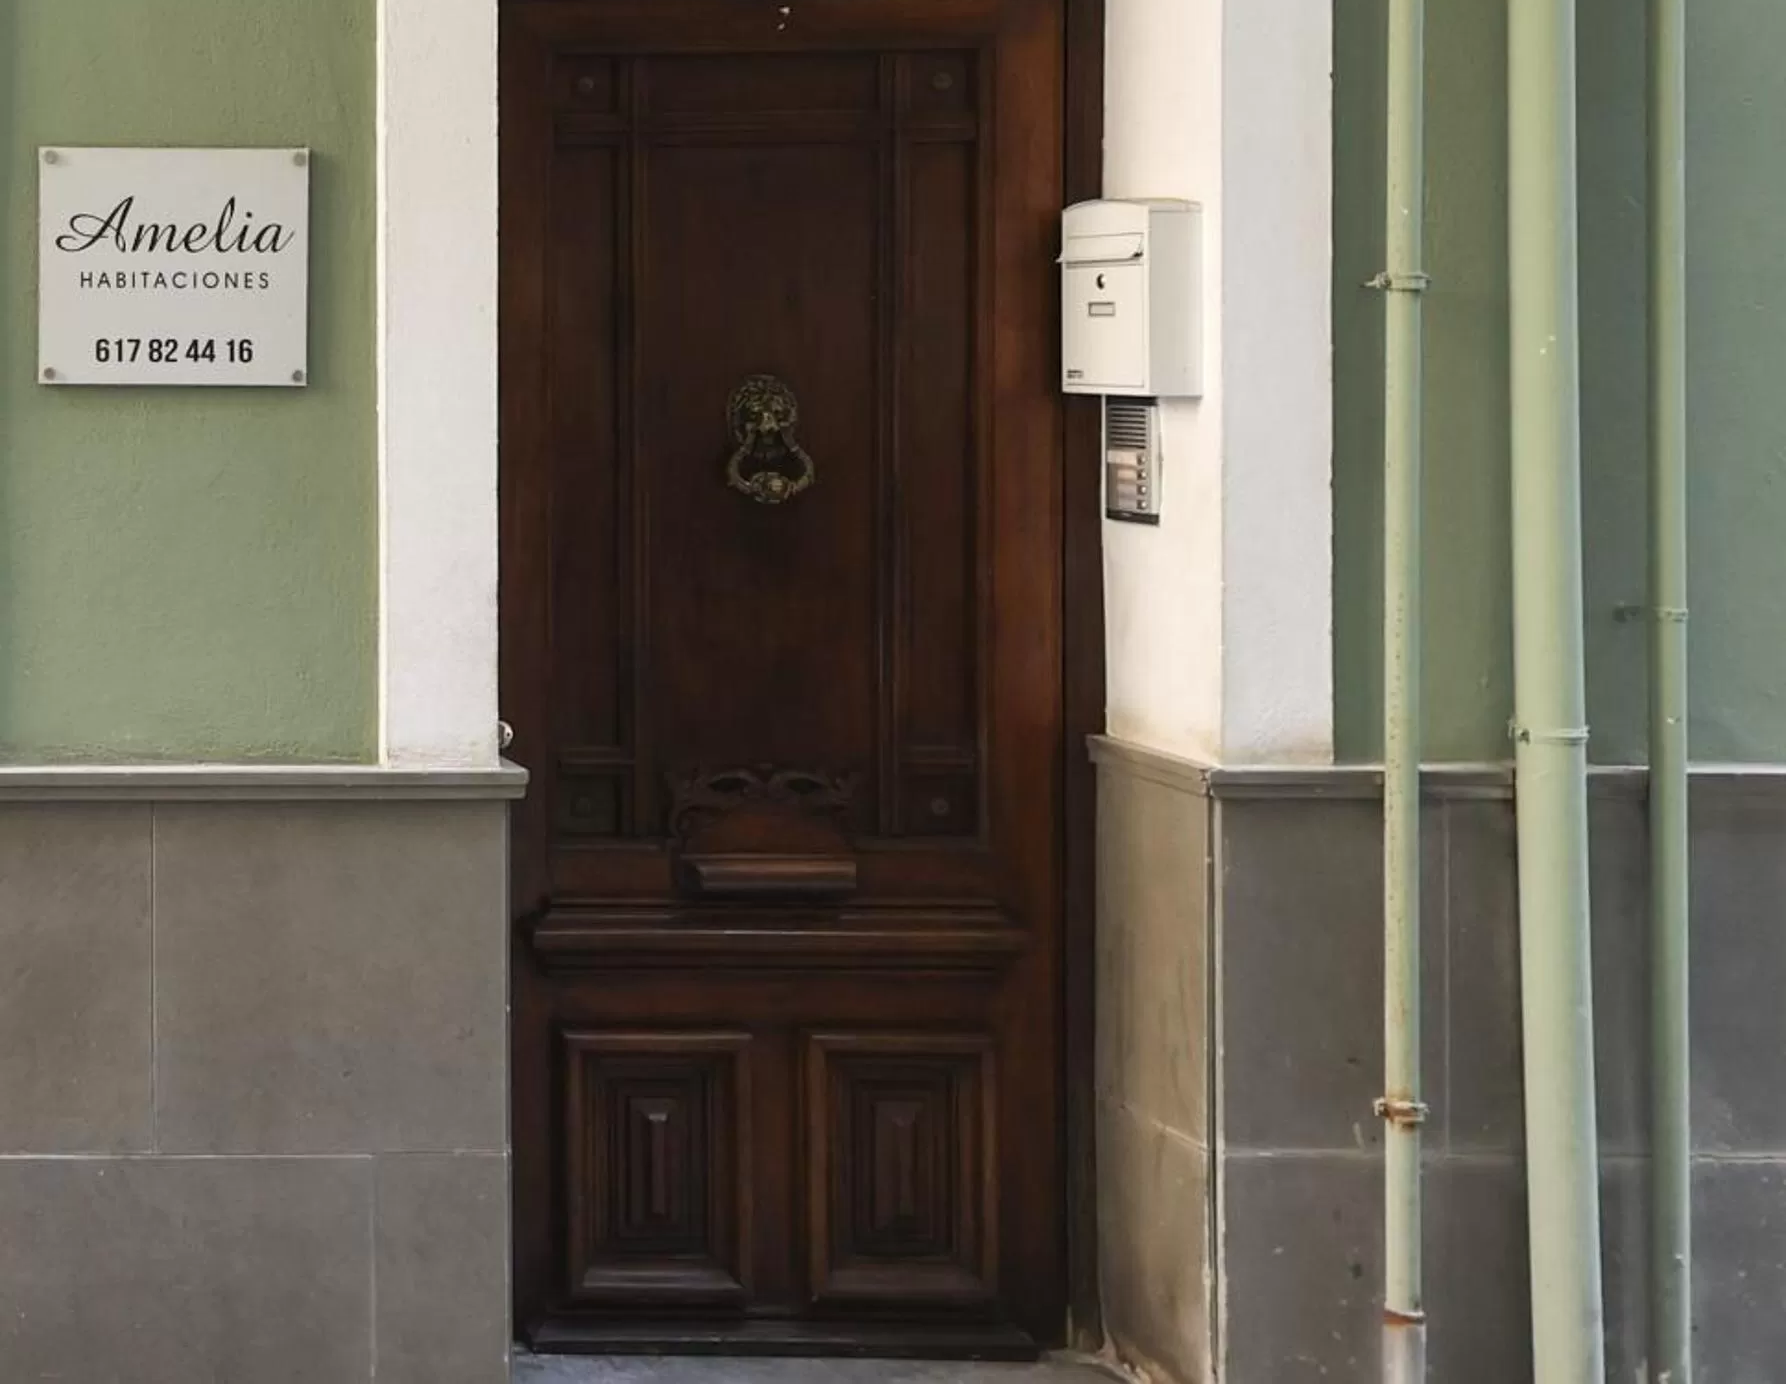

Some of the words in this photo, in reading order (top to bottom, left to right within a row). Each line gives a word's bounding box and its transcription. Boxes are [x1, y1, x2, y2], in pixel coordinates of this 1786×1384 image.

[55, 195, 295, 254] Amelia
[79, 271, 270, 289] HABITACIONES
[95, 338, 141, 363] 617
[148, 338, 178, 363] 82
[185, 338, 216, 363] 44
[226, 338, 254, 363] 16
